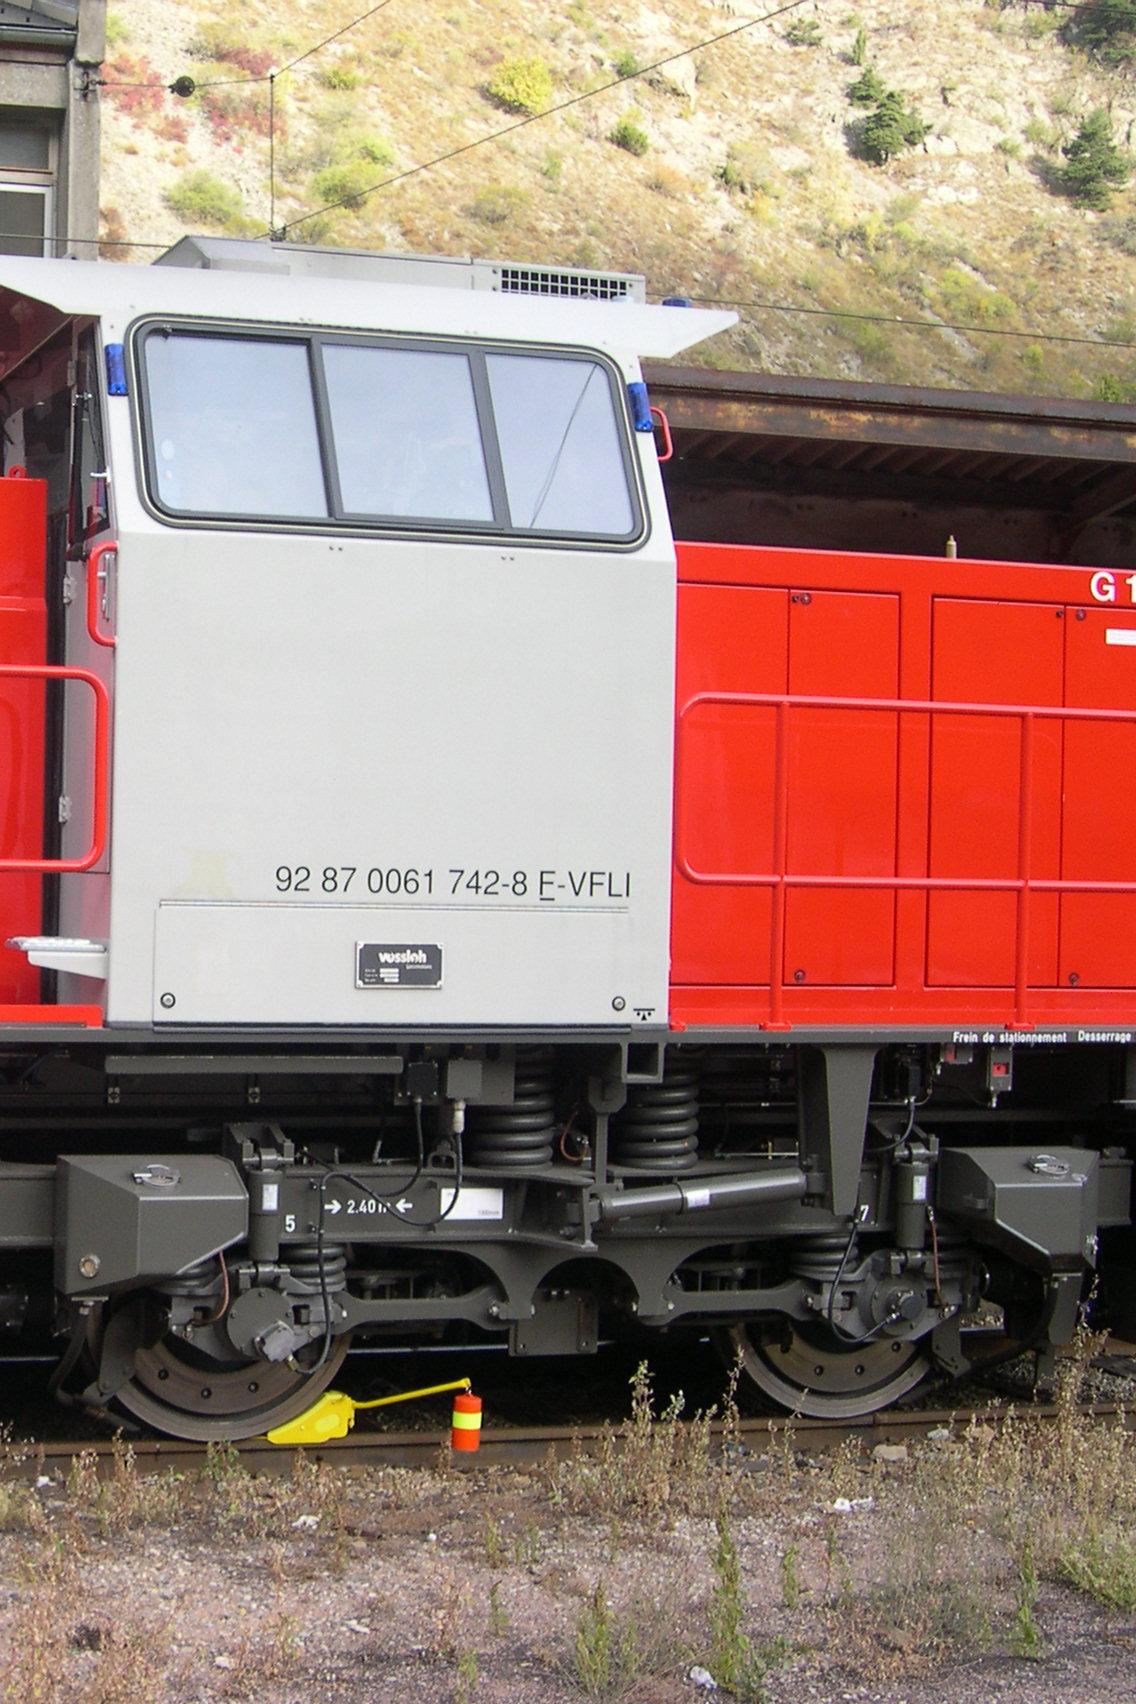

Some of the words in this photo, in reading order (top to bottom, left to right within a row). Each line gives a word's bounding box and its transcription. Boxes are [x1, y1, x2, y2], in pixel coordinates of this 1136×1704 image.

[1090, 571, 1116, 602] G
[275, 866, 311, 892] 92
[321, 867, 357, 893] 87
[367, 868, 434, 895] 0061
[448, 869, 528, 896] 742-8
[538, 870, 631, 900] F-VFLI
[953, 1031, 979, 1043] Frein
[982, 1031, 995, 1043] de
[999, 1031, 1067, 1043] stationnement
[1077, 1030, 1132, 1043] Desserrage
[346, 1199, 376, 1214] 2.40
[285, 1215, 296, 1232] 5
